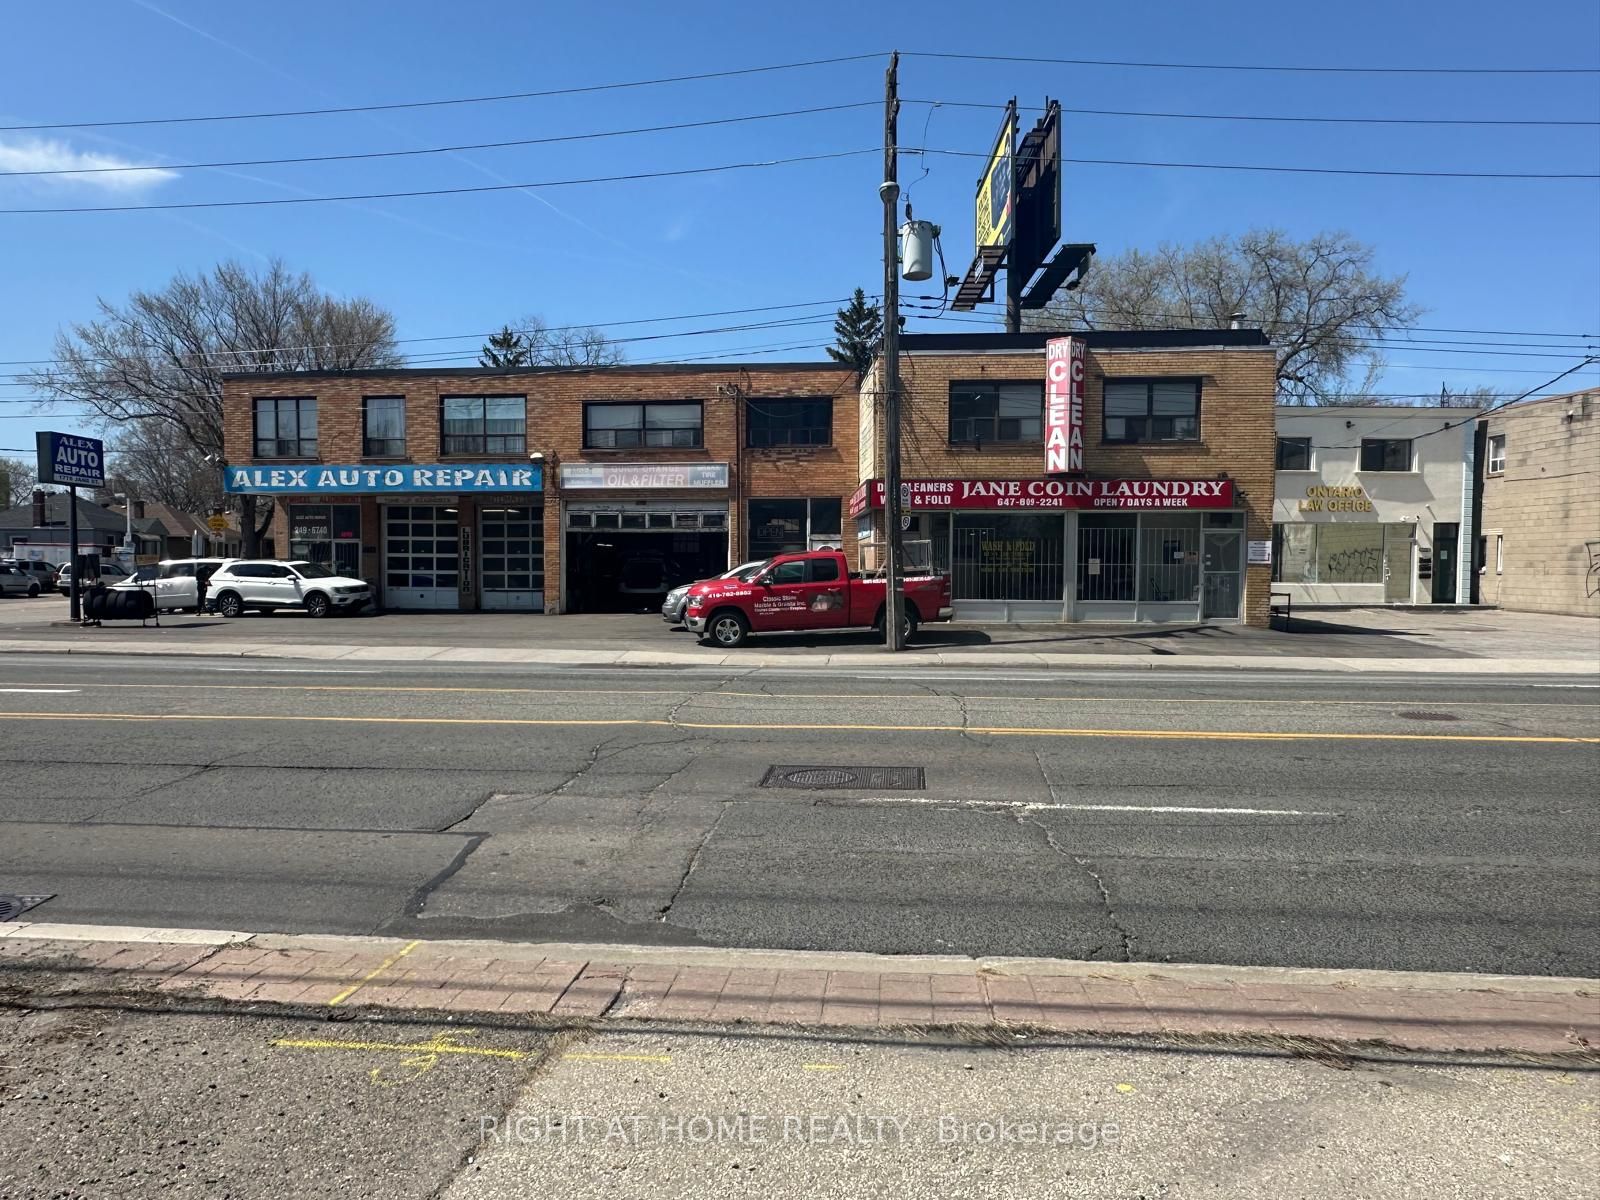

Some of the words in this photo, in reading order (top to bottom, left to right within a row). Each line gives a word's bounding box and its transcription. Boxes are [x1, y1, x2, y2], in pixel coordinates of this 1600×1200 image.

[1049, 341, 1068, 360] DRY
[1071, 342, 1085, 360] DRY
[1048, 360, 1067, 471] CLEAN
[1070, 360, 1083, 471] CLEAN
[60, 436, 94, 450] ALEX
[56, 446, 99, 468] AUTO
[54, 463, 101, 478] REPAIR
[232, 470, 308, 488] ALEX
[317, 470, 404, 487] AUTO
[413, 469, 533, 487] REPAIR
[701, 471, 717, 479] TIRE
[961, 481, 1021, 499] JANE
[1027, 481, 1093, 497] COIN
[1100, 481, 1226, 496] LAUNDRY
[1306, 485, 1363, 498] ONTARIO
[914, 495, 923, 505] &
[925, 495, 951, 505] FOLD
[1094, 498, 1118, 507] OPEN
[1119, 498, 1125, 507] 7
[1127, 498, 1153, 507] DAYS
[1154, 498, 1161, 507] A
[1162, 498, 1188, 507] WEEK
[1298, 499, 1324, 512] LAW
[1327, 499, 1373, 512] OFFICE
